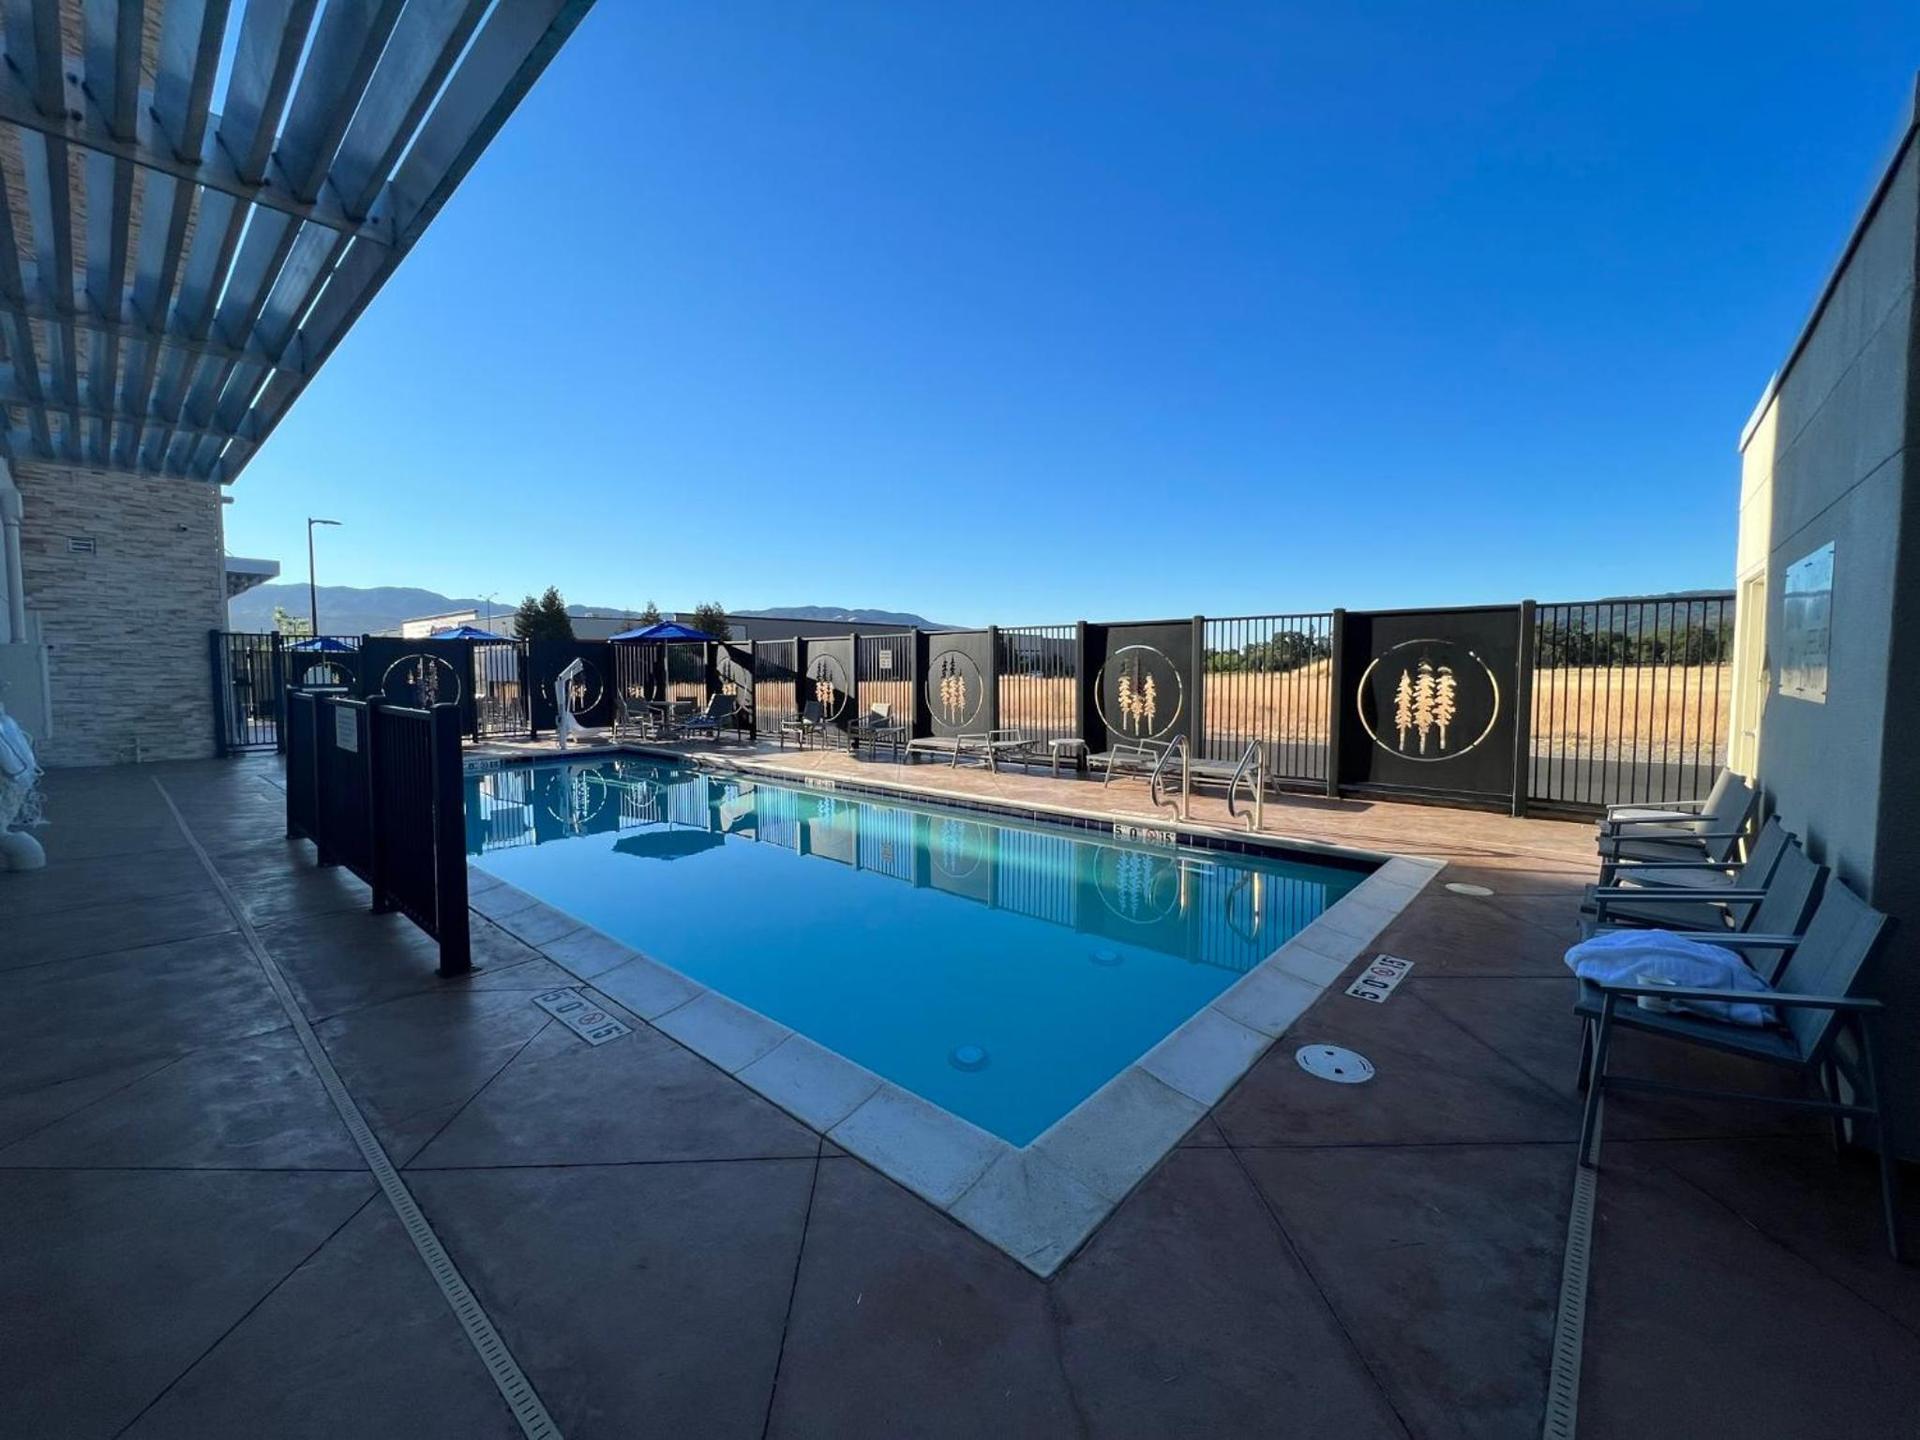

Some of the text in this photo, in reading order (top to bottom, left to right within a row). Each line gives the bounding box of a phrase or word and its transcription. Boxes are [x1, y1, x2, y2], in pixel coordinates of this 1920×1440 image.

[1115, 825, 1122, 840] 5
[1362, 978, 1389, 989] 0
[1351, 989, 1380, 1000] 5
[542, 991, 568, 1003] 5
[556, 1002, 584, 1013] 0
